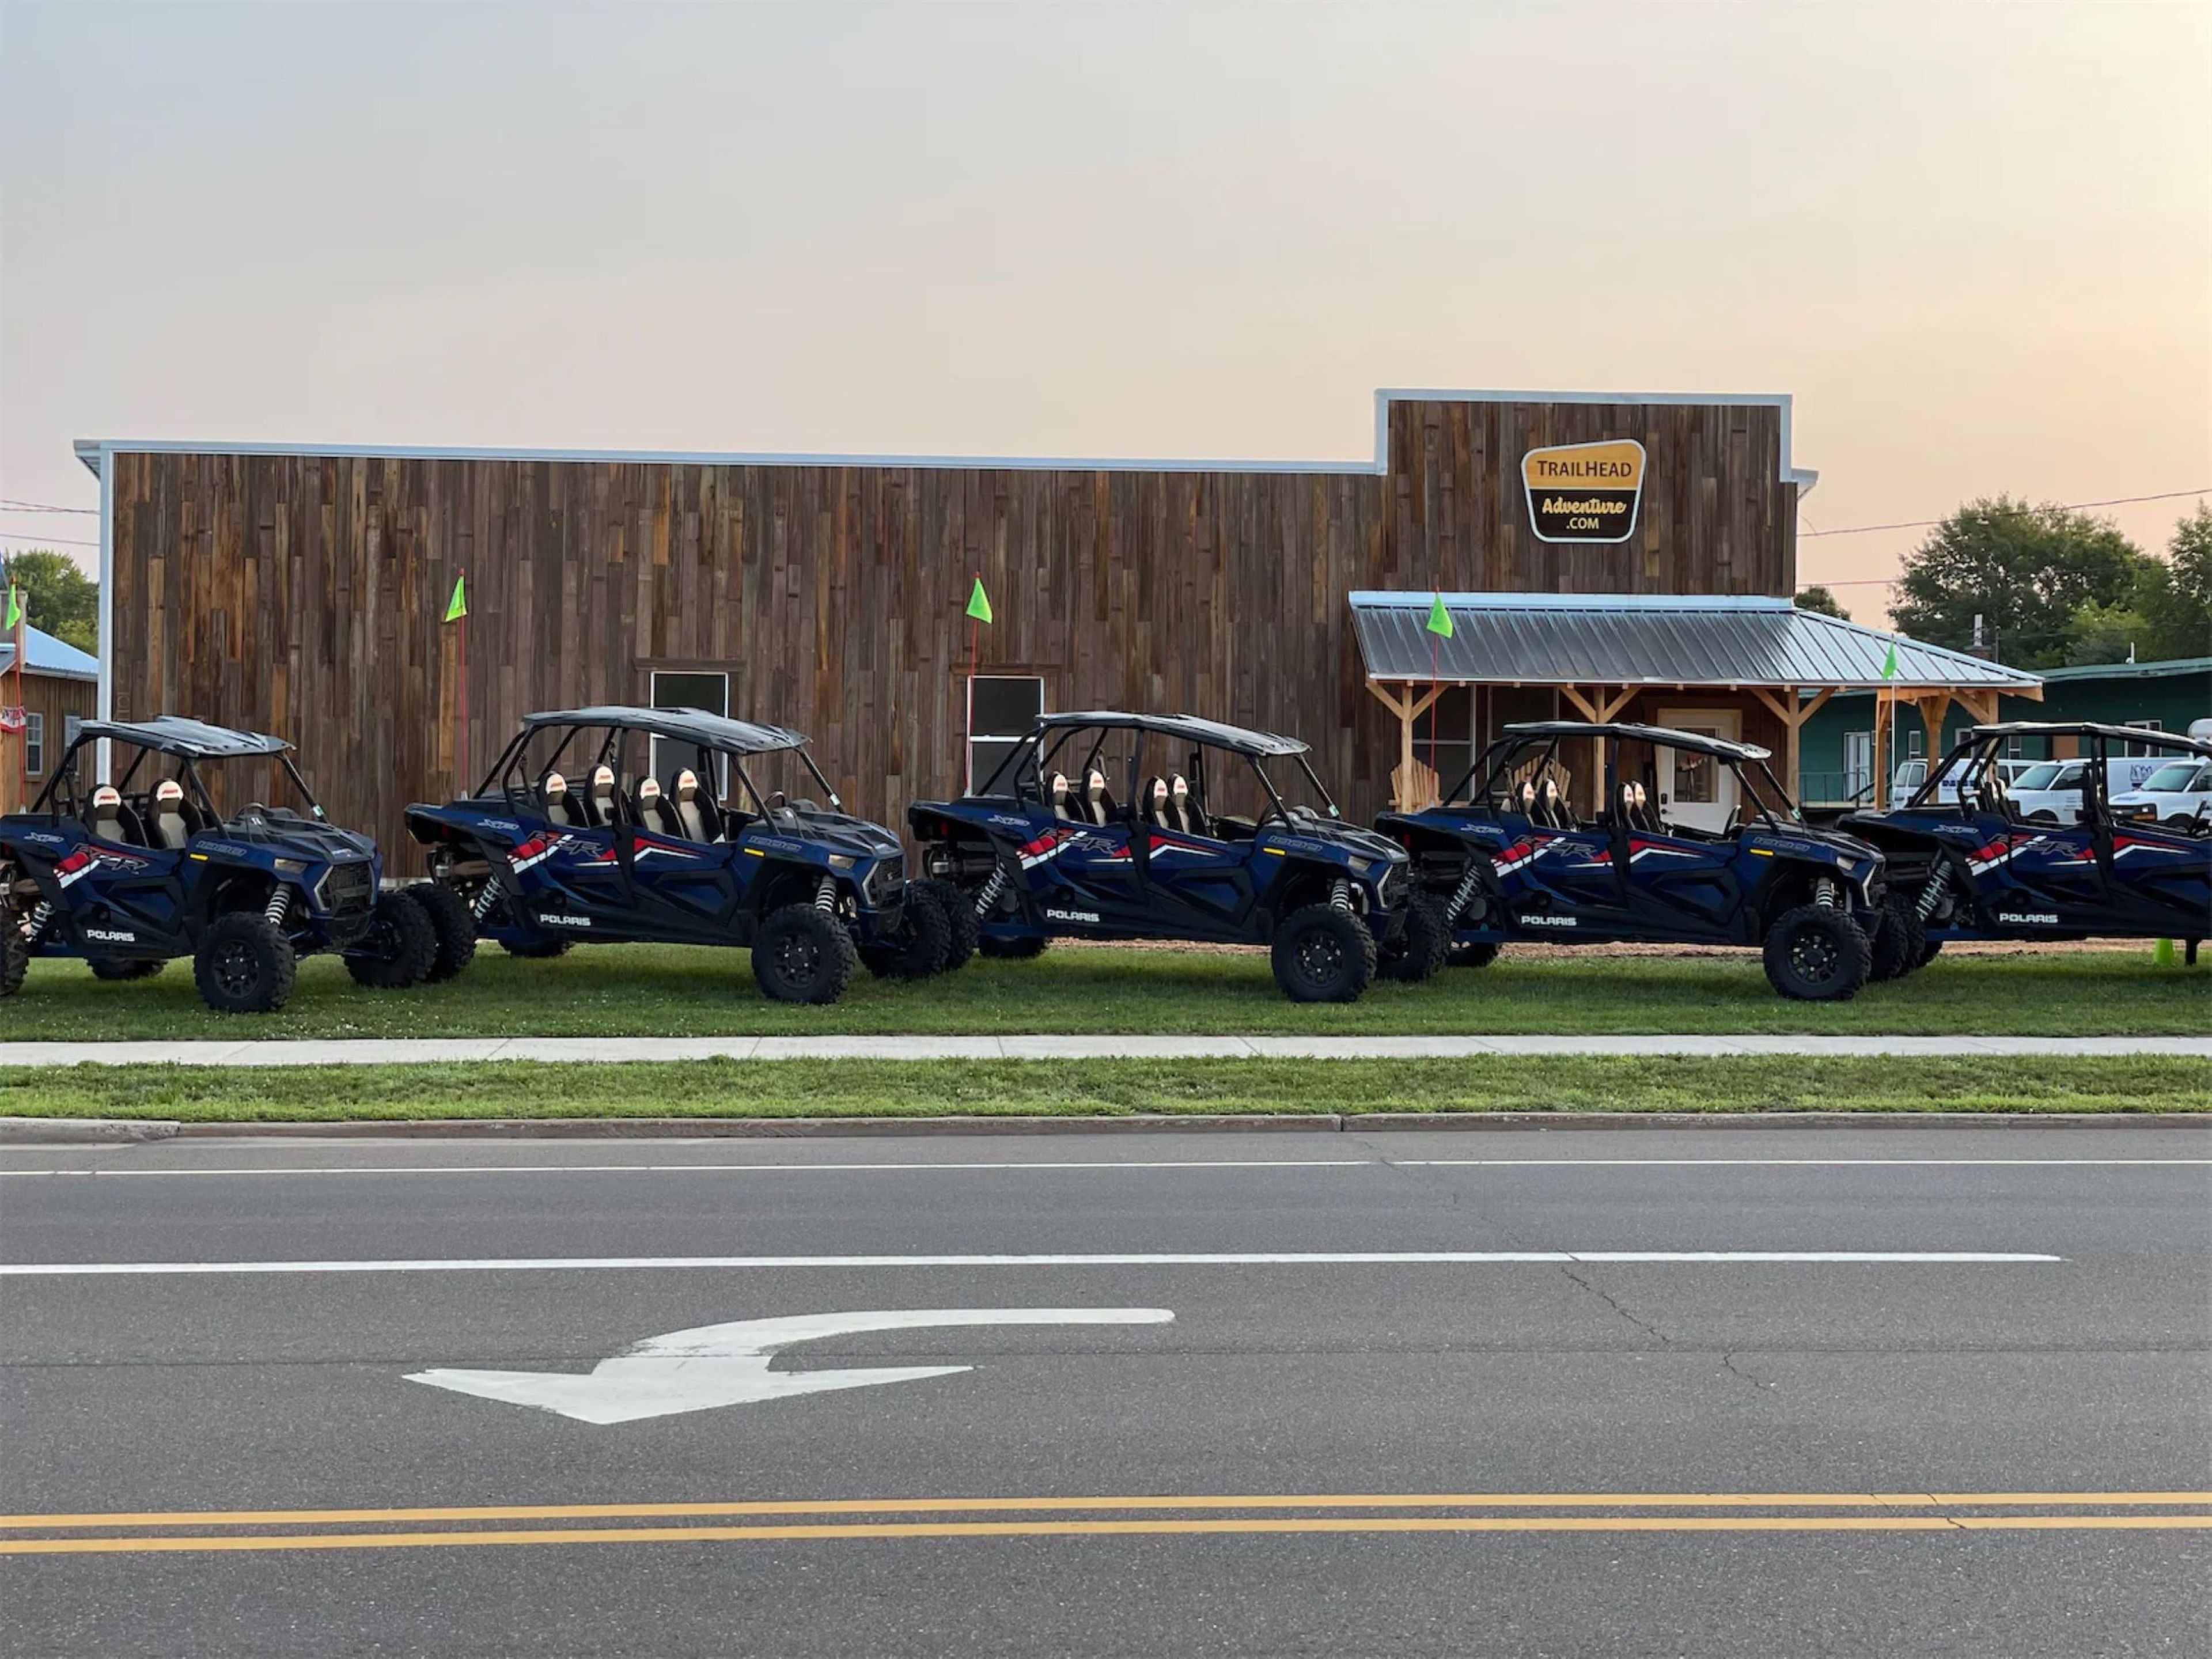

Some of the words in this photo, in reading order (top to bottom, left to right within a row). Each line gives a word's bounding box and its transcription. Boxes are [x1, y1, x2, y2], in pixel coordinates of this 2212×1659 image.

[1537, 461, 1632, 477] TRAILHEAD
[1542, 496, 1626, 514] Adventure
[1566, 518, 1600, 529] .COM
[540, 914, 591, 926] POLARIS
[1047, 909, 1100, 922] POLARIS
[1521, 915, 1577, 926] POLARIS
[1999, 912, 2058, 923] POLARIS
[87, 929, 135, 942] POLARIS
